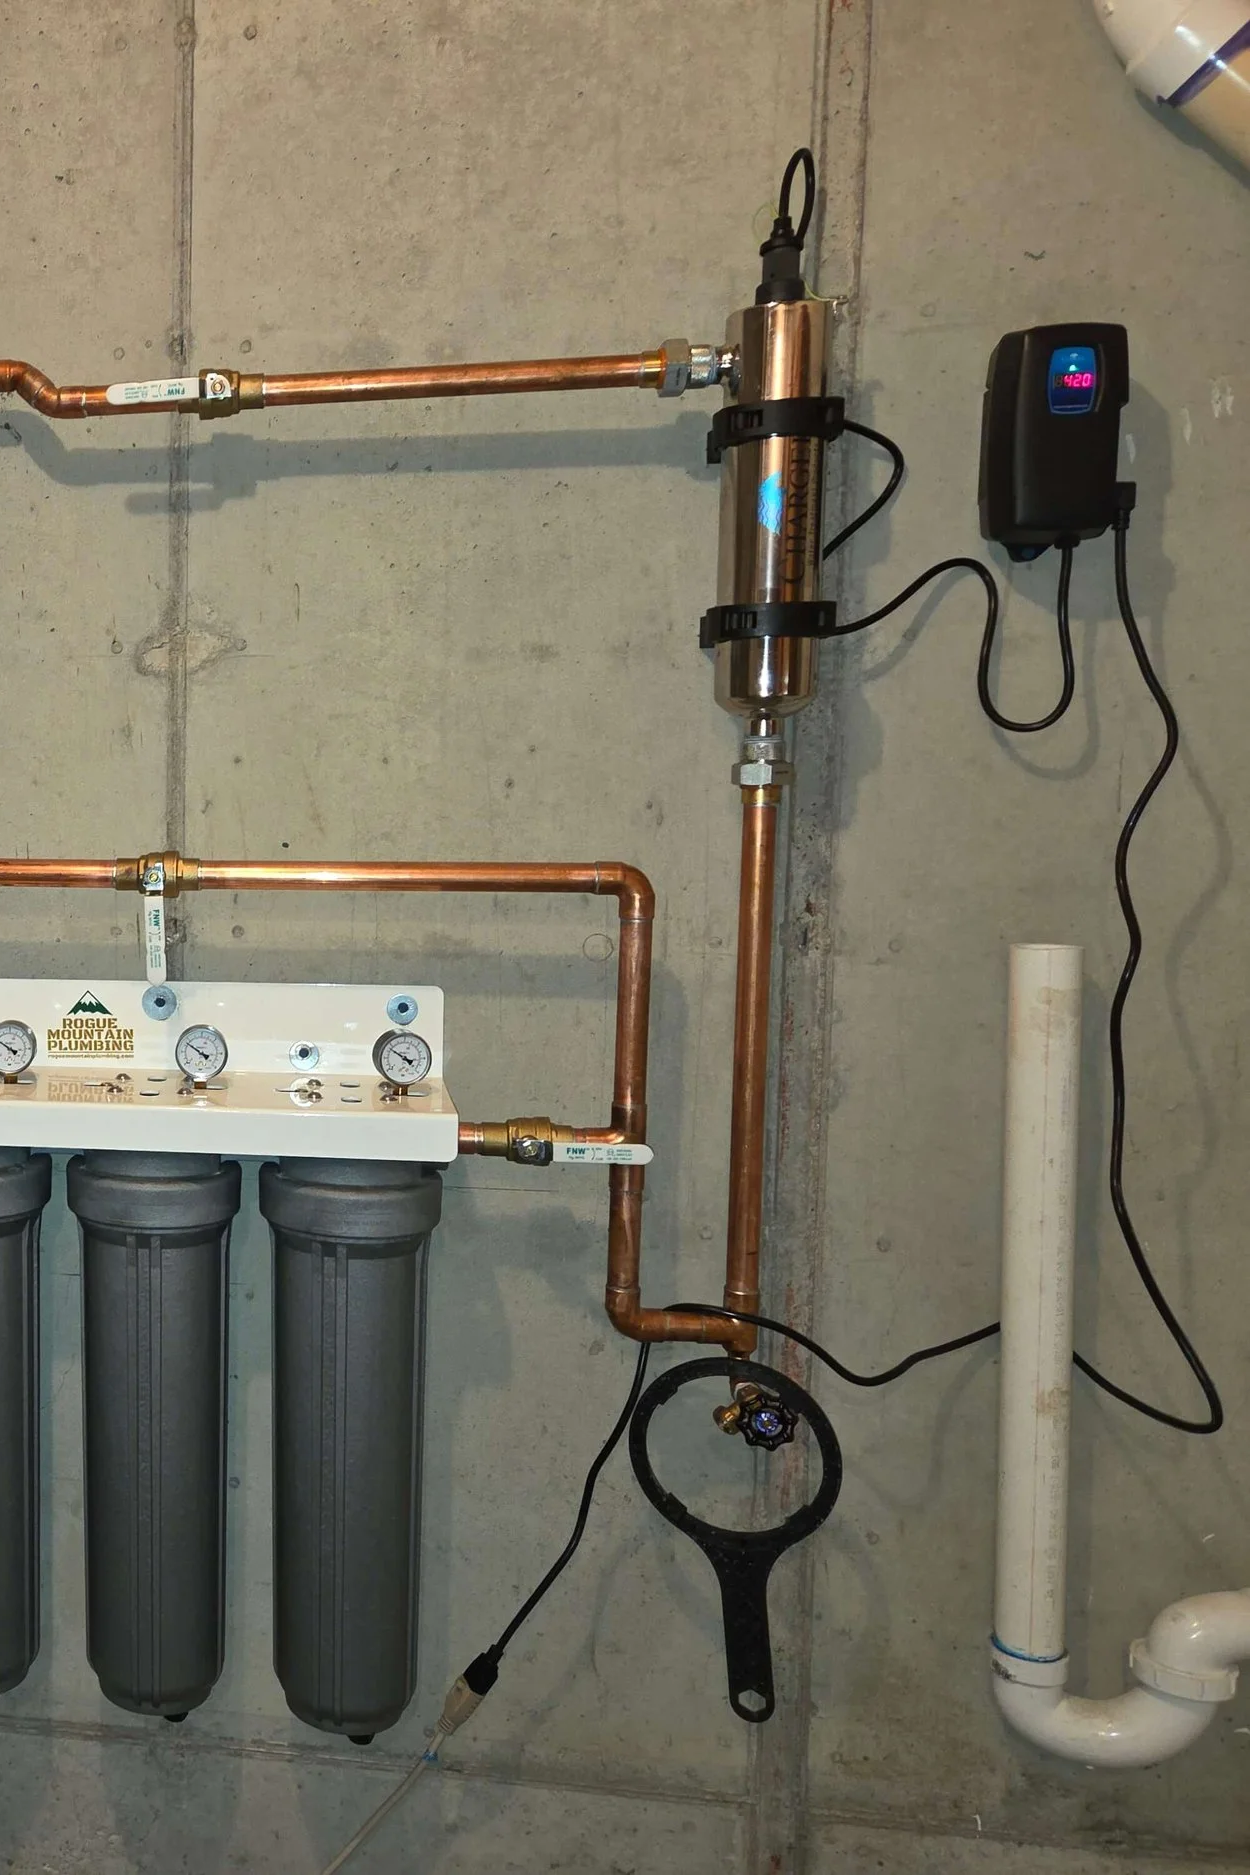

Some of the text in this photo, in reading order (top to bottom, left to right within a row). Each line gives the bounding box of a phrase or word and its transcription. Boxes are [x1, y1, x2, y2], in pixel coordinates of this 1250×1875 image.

[152, 909, 160, 927] FNW
[62, 1018, 118, 1029] ROGUE
[47, 1029, 134, 1040] MOUNTAIN
[47, 1040, 134, 1051] PLUMBING
[566, 1147, 586, 1155] FNW
